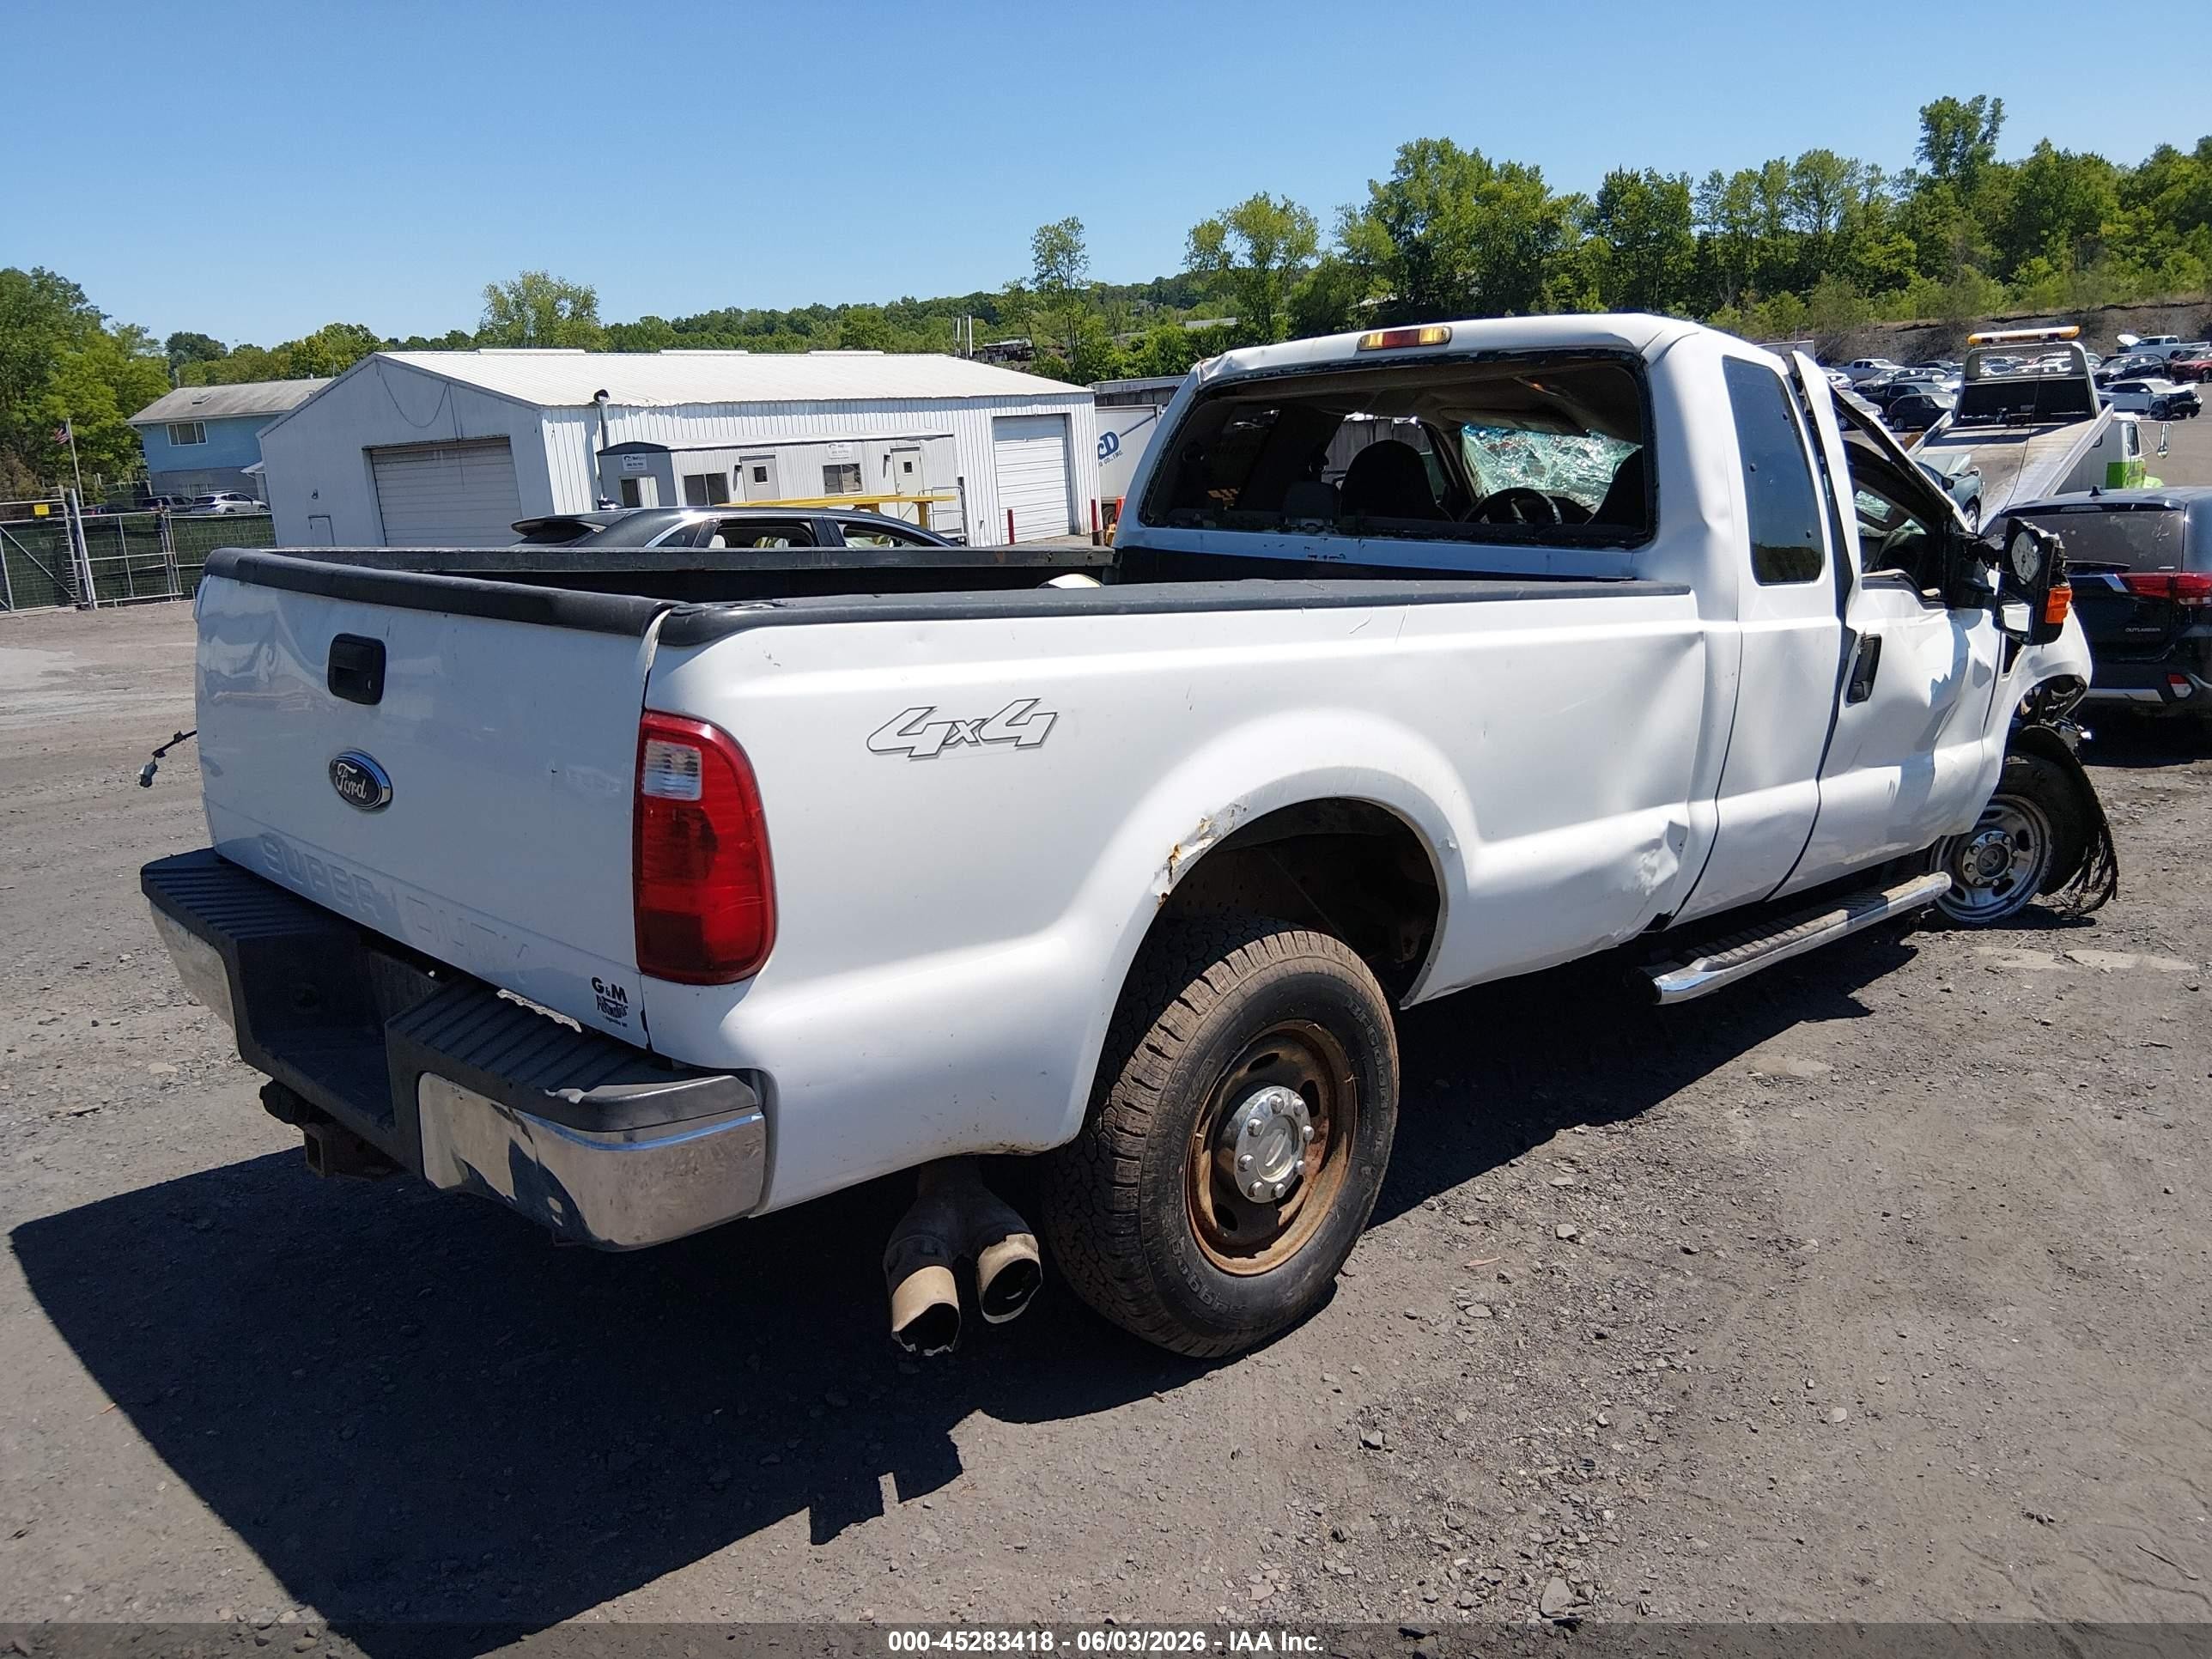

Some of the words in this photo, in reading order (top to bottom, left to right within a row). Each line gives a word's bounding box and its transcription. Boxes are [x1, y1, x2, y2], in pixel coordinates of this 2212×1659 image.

[866, 697, 1059, 761] 4x4
[335, 763, 368, 799] Ford
[260, 830, 383, 921] SUPER
